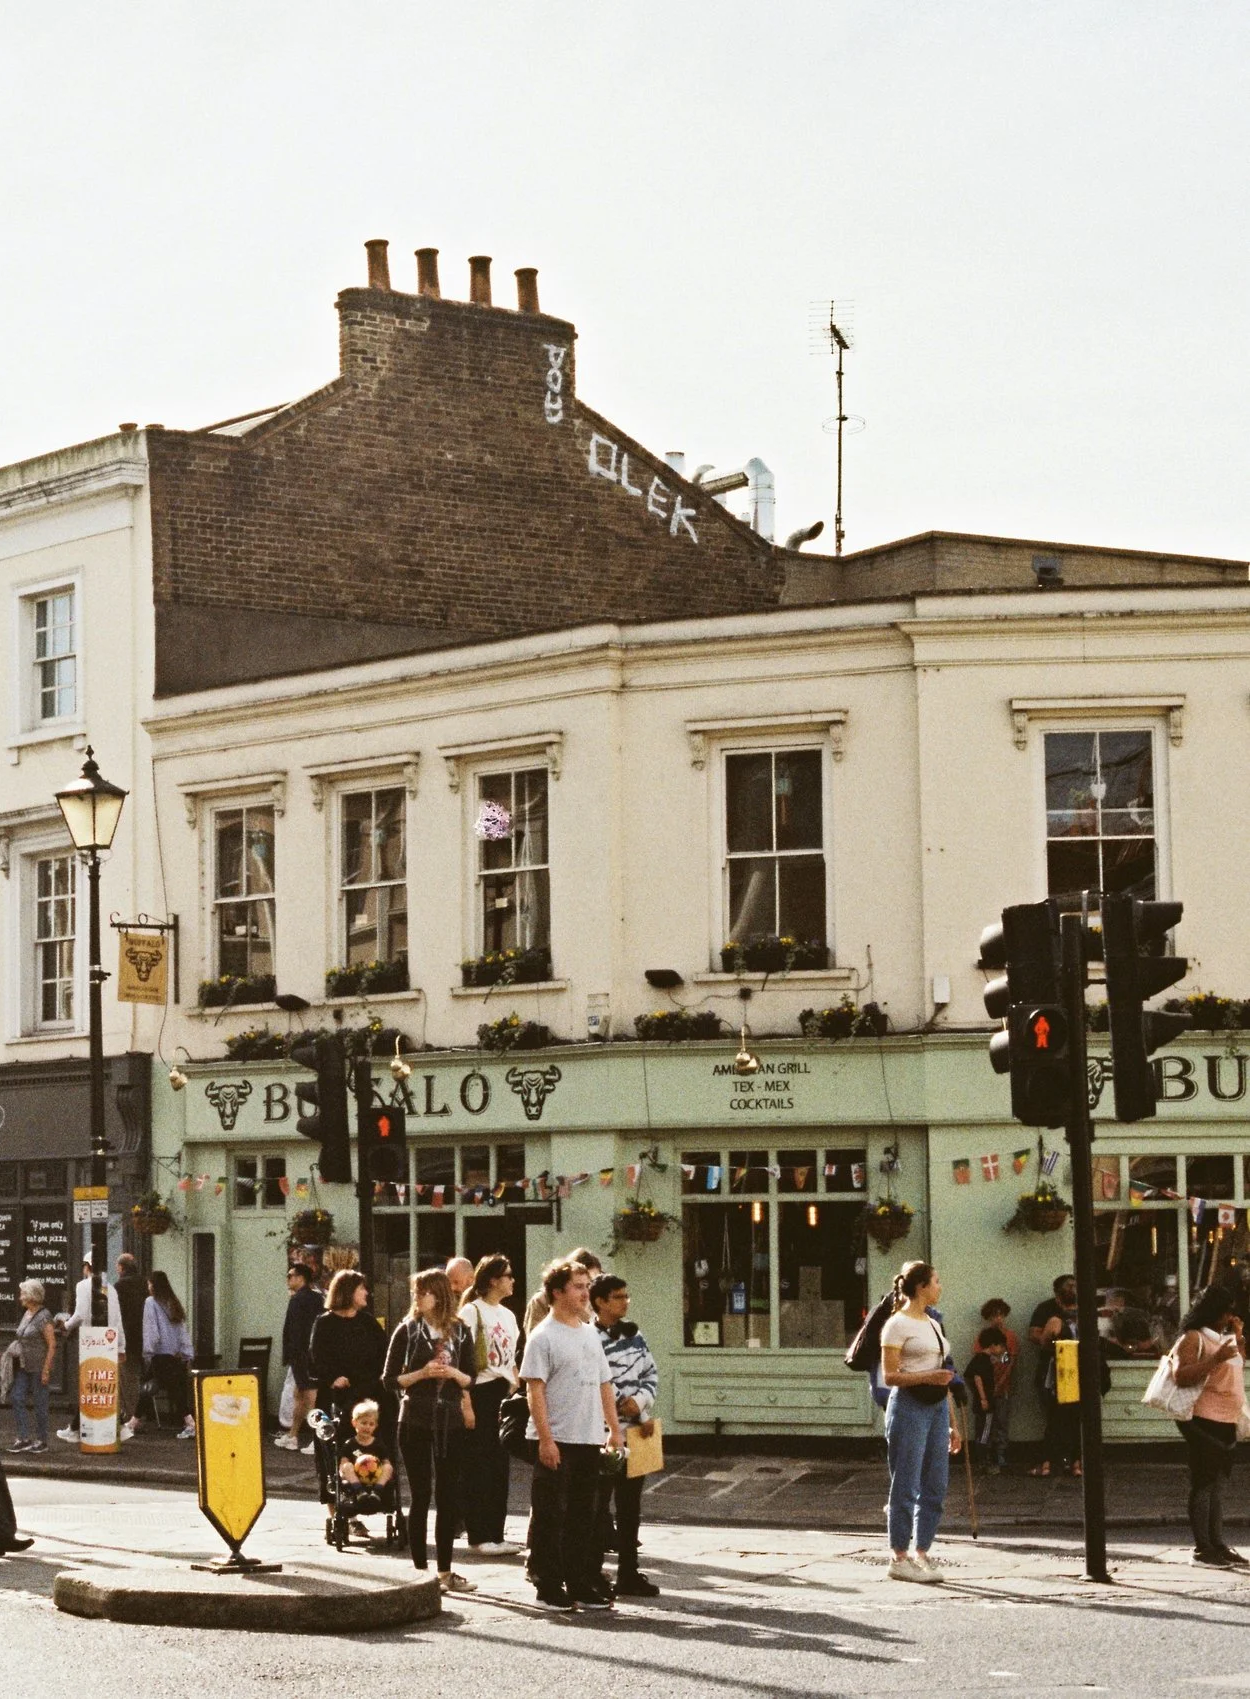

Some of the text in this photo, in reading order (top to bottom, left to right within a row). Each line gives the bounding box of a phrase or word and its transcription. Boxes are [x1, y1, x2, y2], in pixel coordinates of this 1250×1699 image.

[712, 1062, 811, 1076] AMAN GRILL
[732, 1081, 754, 1092] TEX
[764, 1080, 790, 1091] MEX
[263, 1073, 492, 1124] BALO
[729, 1098, 794, 1110] COCKTAILS
[39, 1222, 50, 1230] you
[50, 1220, 64, 1230] only
[49, 1235, 68, 1245] pizza
[33, 1247, 44, 1257] this
[26, 1262, 42, 1270] make
[42, 1263, 56, 1271] sure
[87, 1370, 116, 1382] TIME
[86, 1382, 116, 1396] Well
[80, 1395, 114, 1406] SPENT
